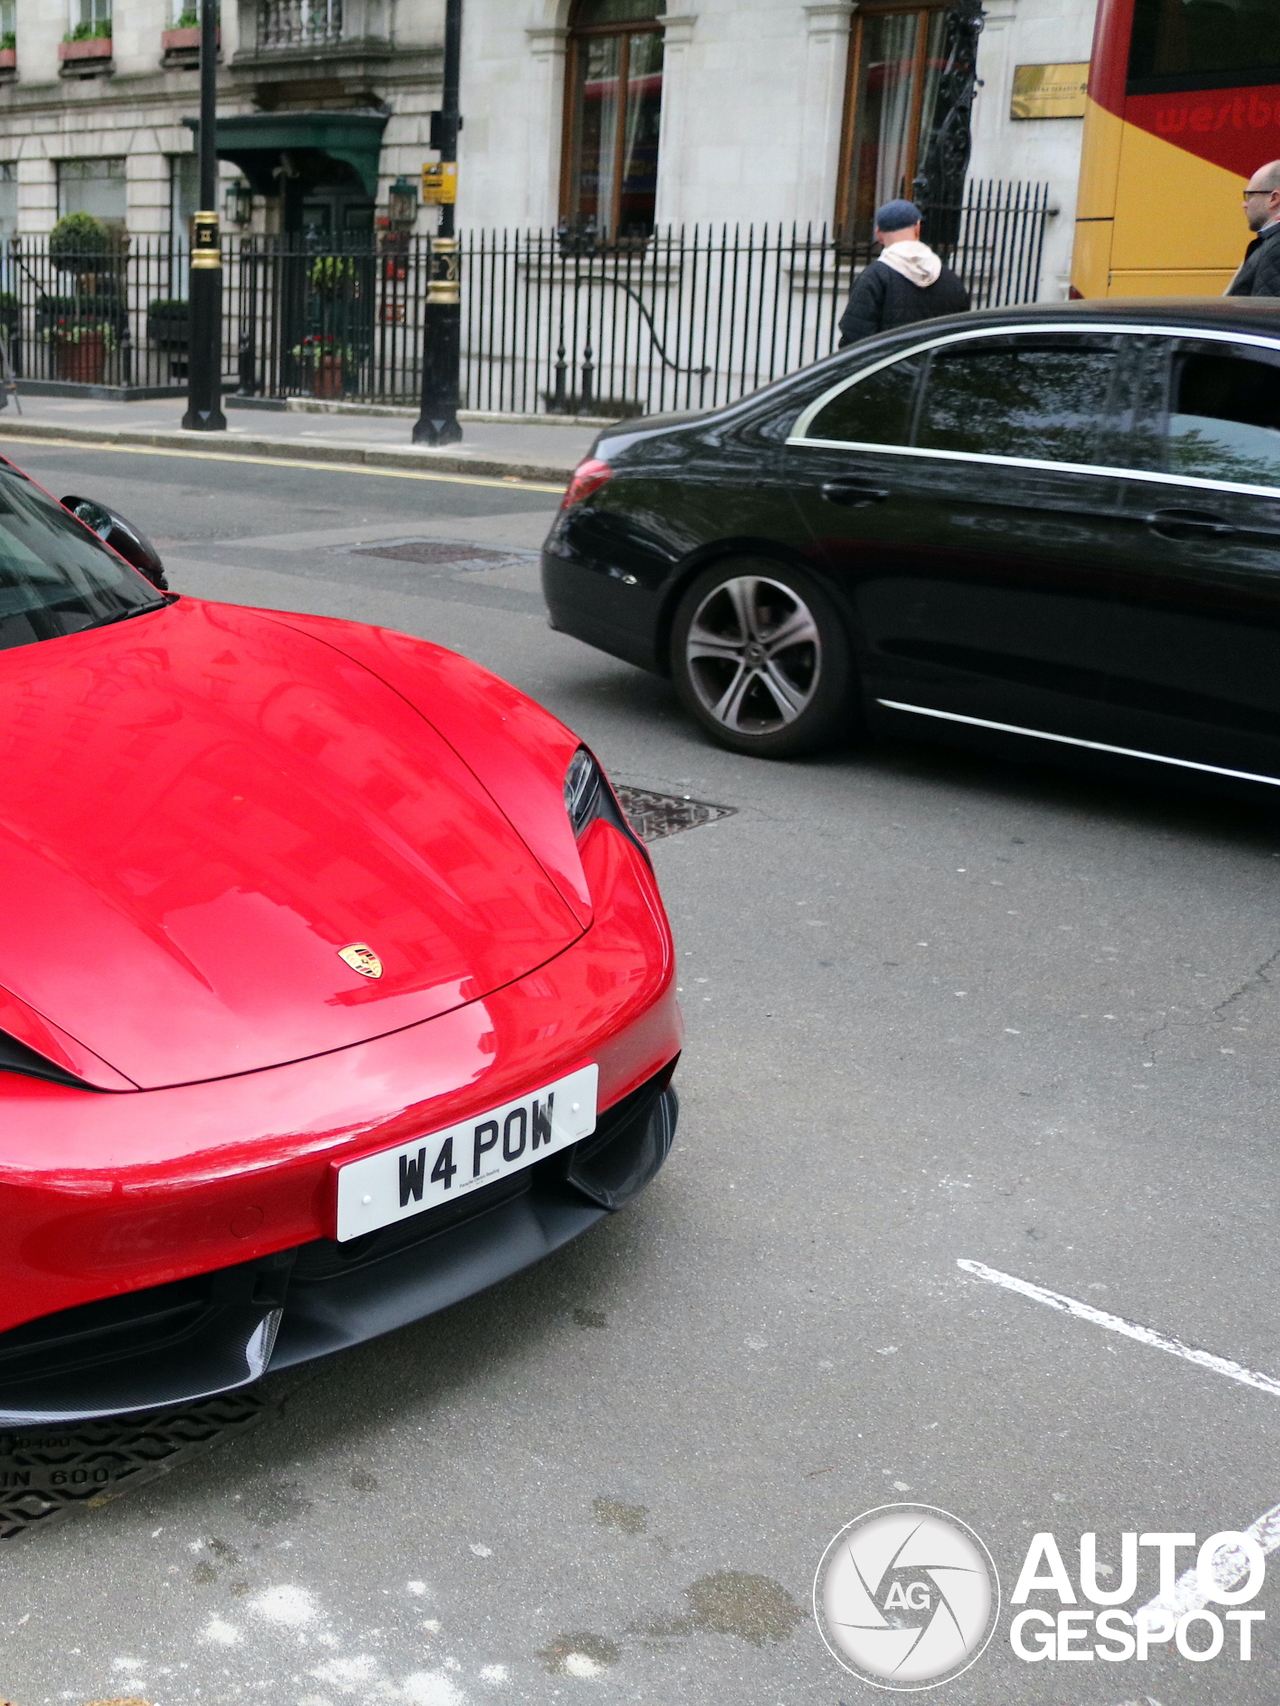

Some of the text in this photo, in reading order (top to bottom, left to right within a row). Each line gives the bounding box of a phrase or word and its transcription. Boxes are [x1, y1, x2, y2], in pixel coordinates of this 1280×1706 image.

[399, 1091, 555, 1208] W4 POW
[51, 1467, 109, 1486] 600
